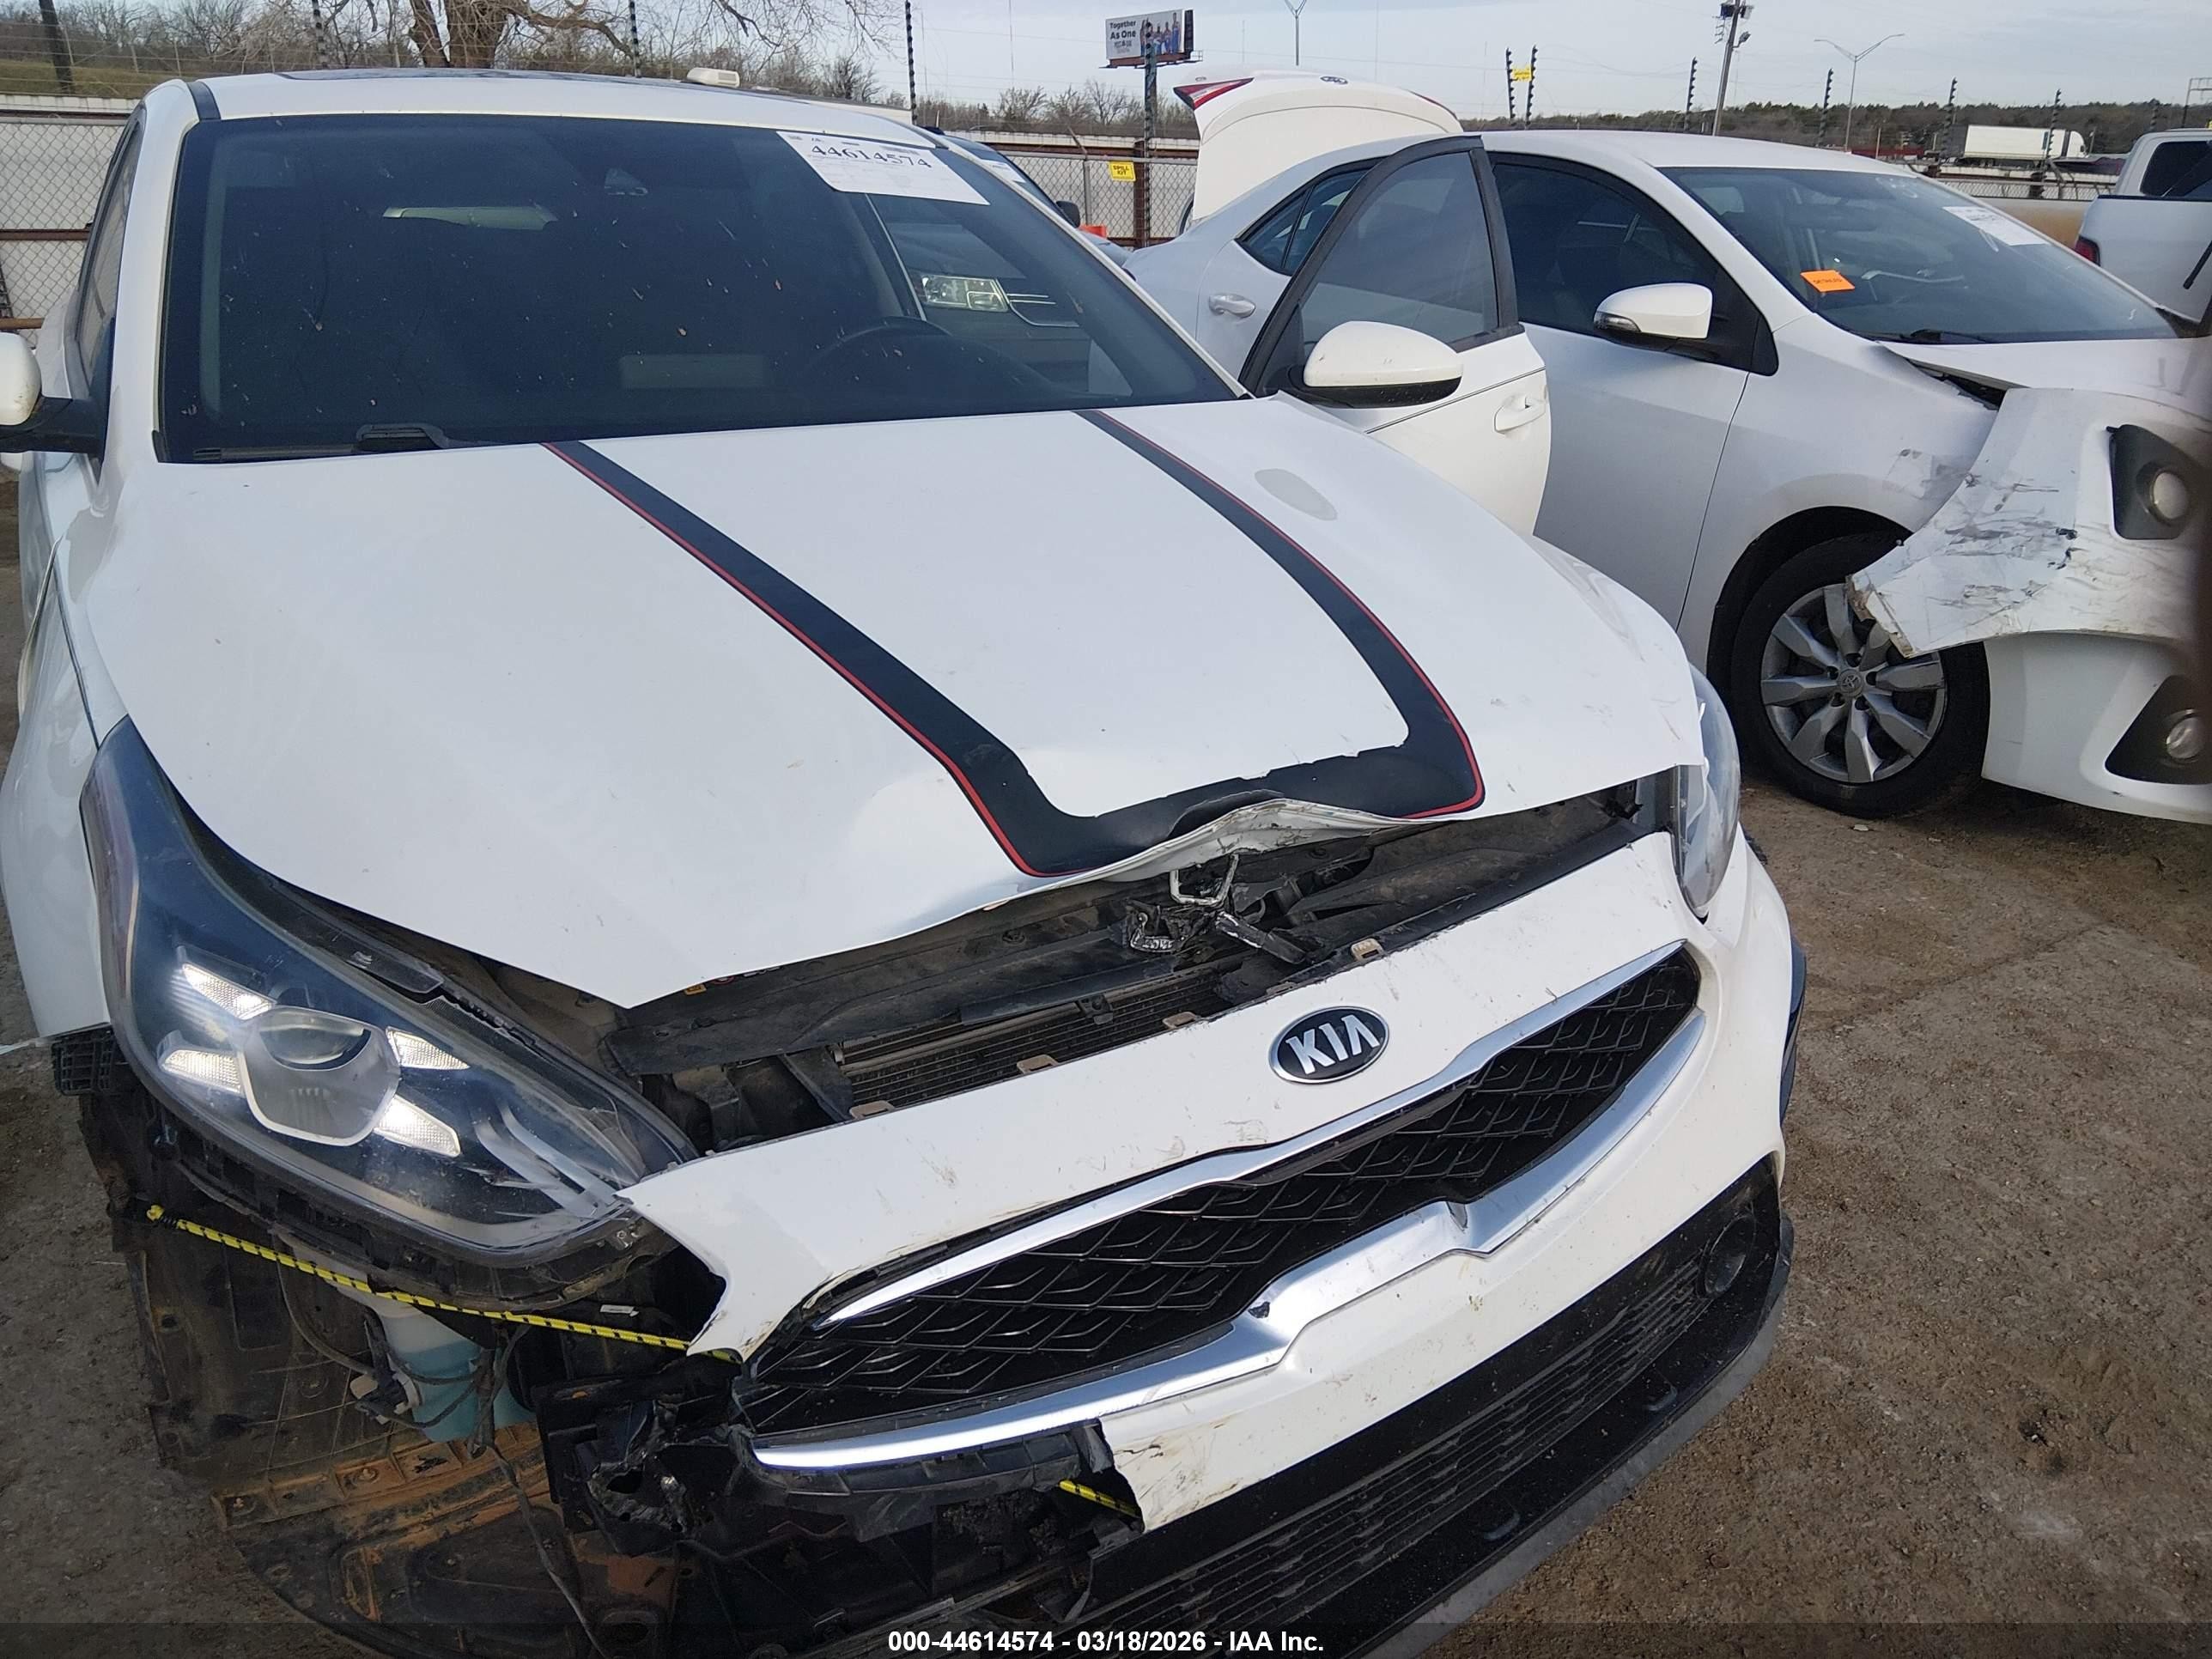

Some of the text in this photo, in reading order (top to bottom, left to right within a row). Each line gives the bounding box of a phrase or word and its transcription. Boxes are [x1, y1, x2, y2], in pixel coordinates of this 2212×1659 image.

[1109, 21, 1136, 29] Together
[1110, 30, 1136, 40] As One
[811, 145, 933, 168] 44614574
[1285, 1014, 1380, 1074] KIA
